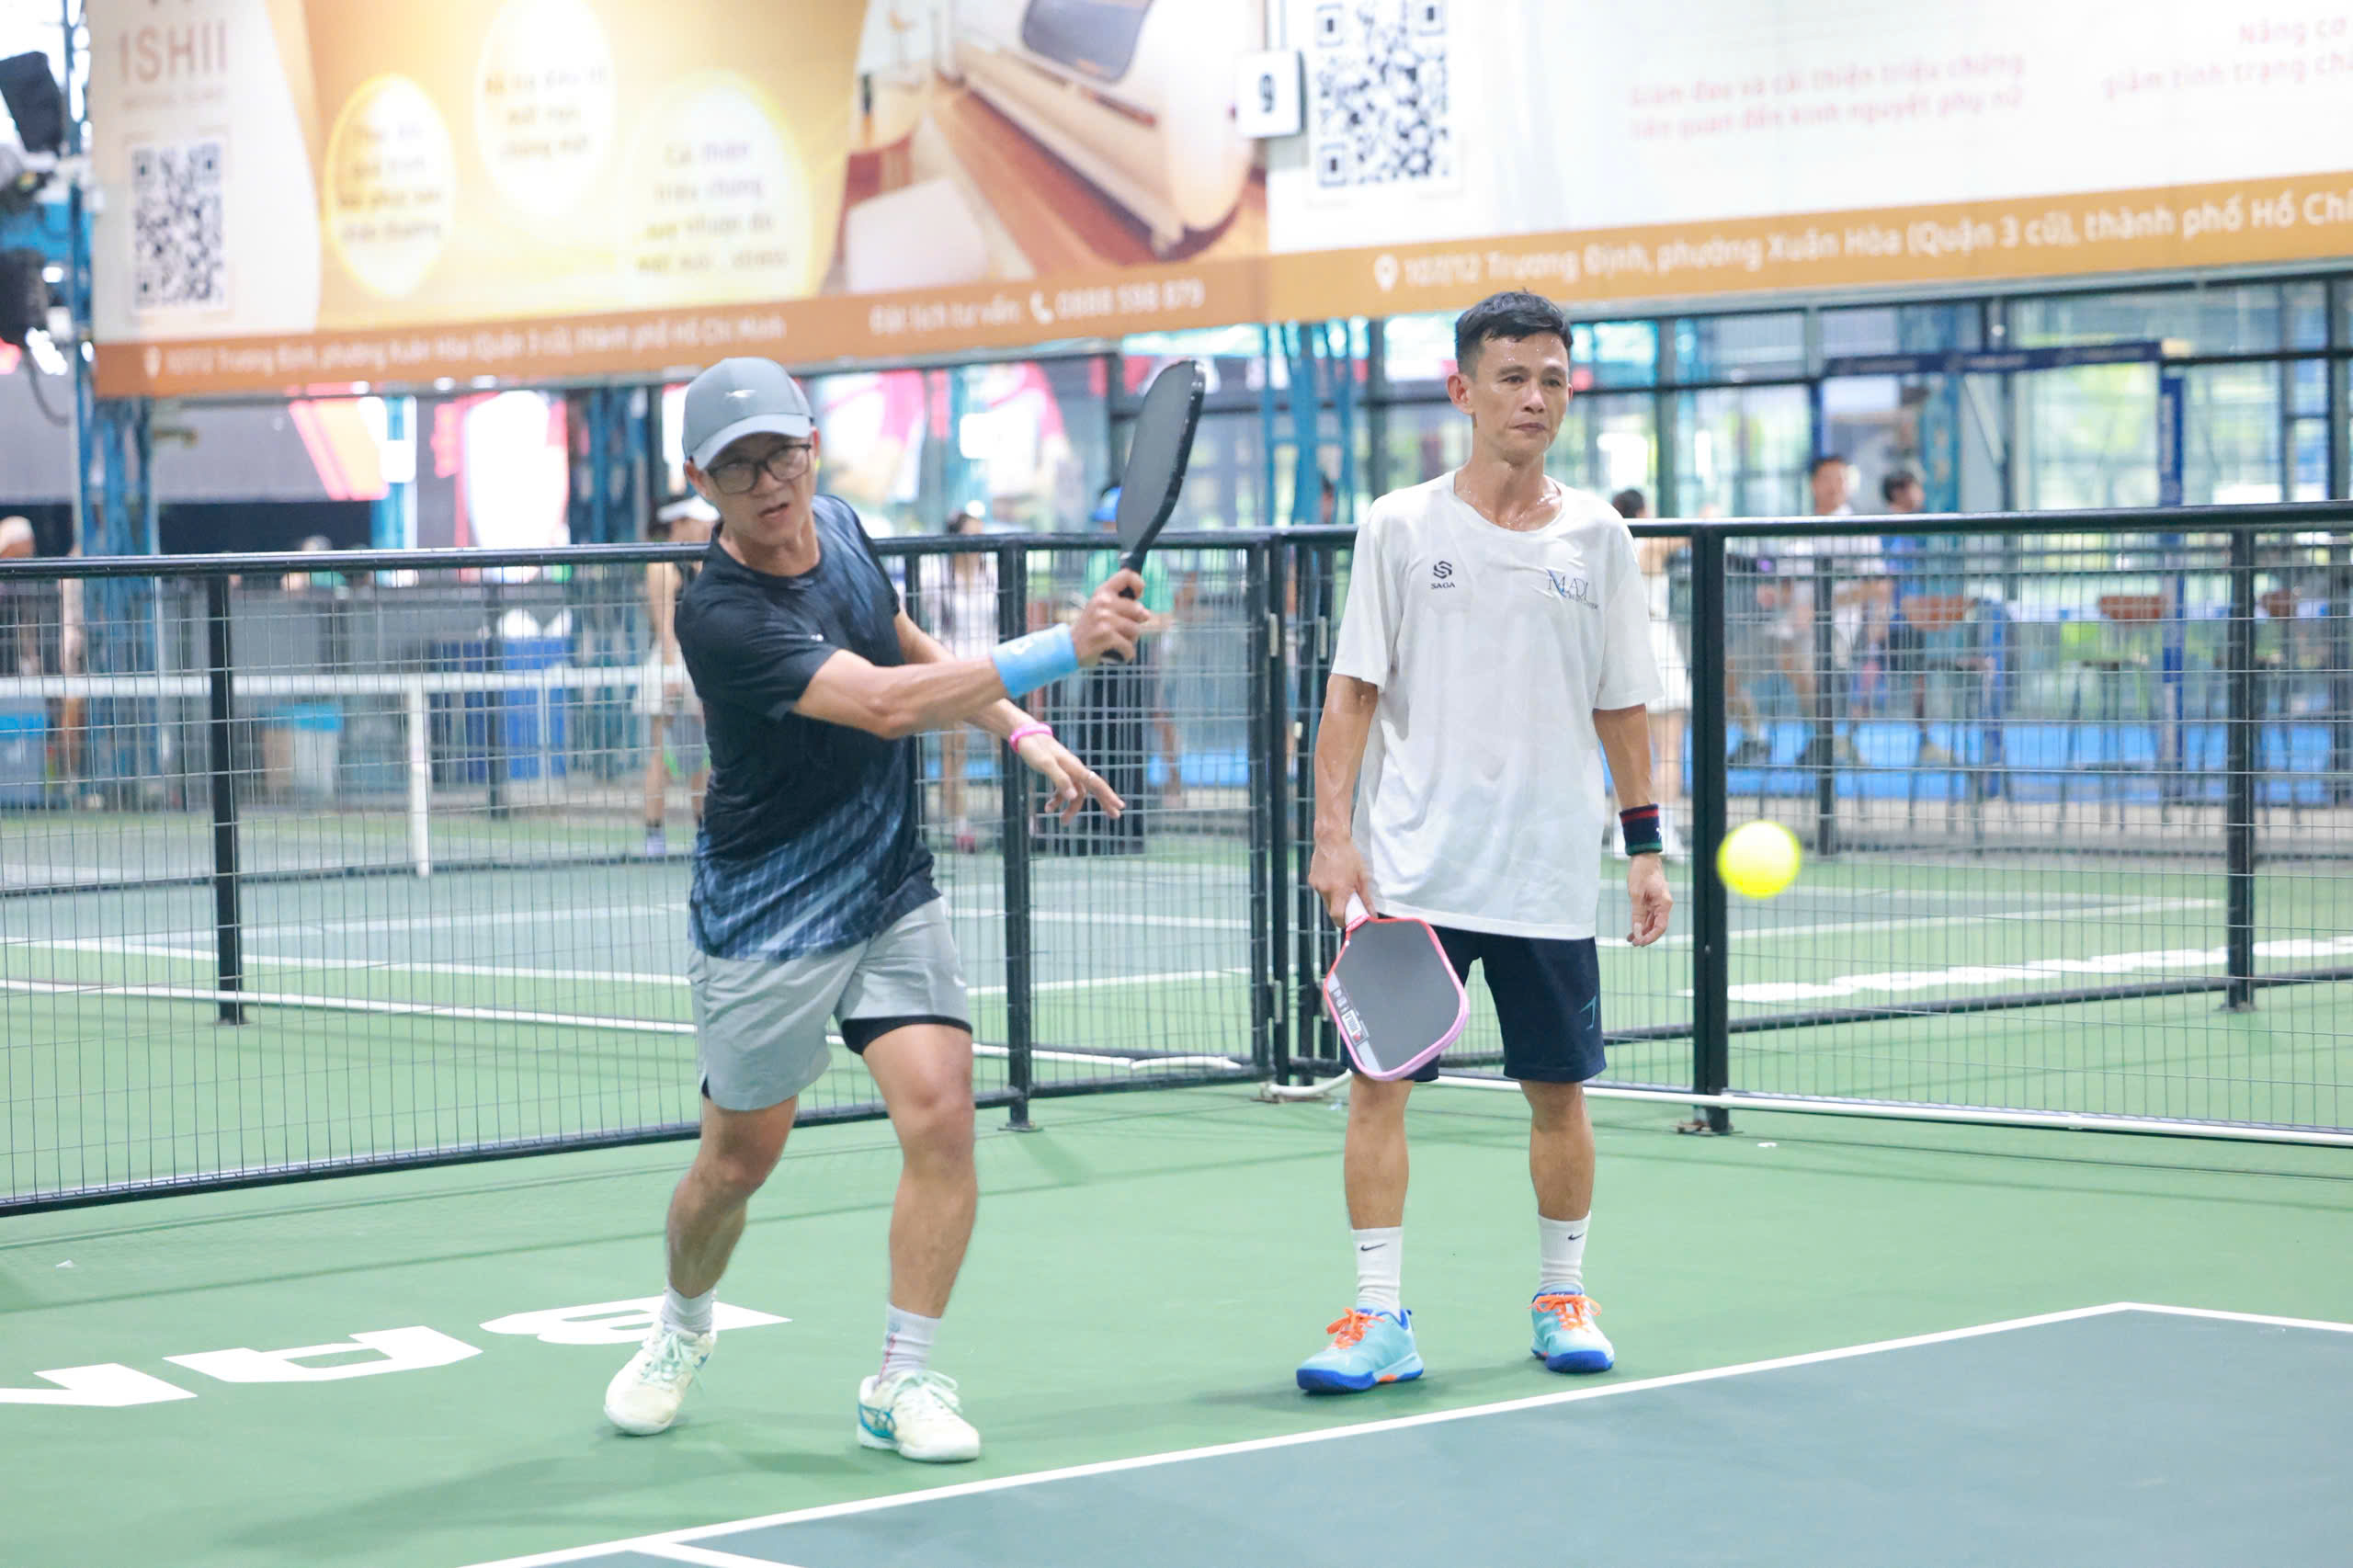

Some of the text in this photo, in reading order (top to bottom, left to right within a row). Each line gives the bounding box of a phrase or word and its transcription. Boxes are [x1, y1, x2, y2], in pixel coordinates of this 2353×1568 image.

[119, 20, 229, 83] ISHII
[1258, 73, 1277, 113] 9
[1430, 582, 1456, 590] SAGA
